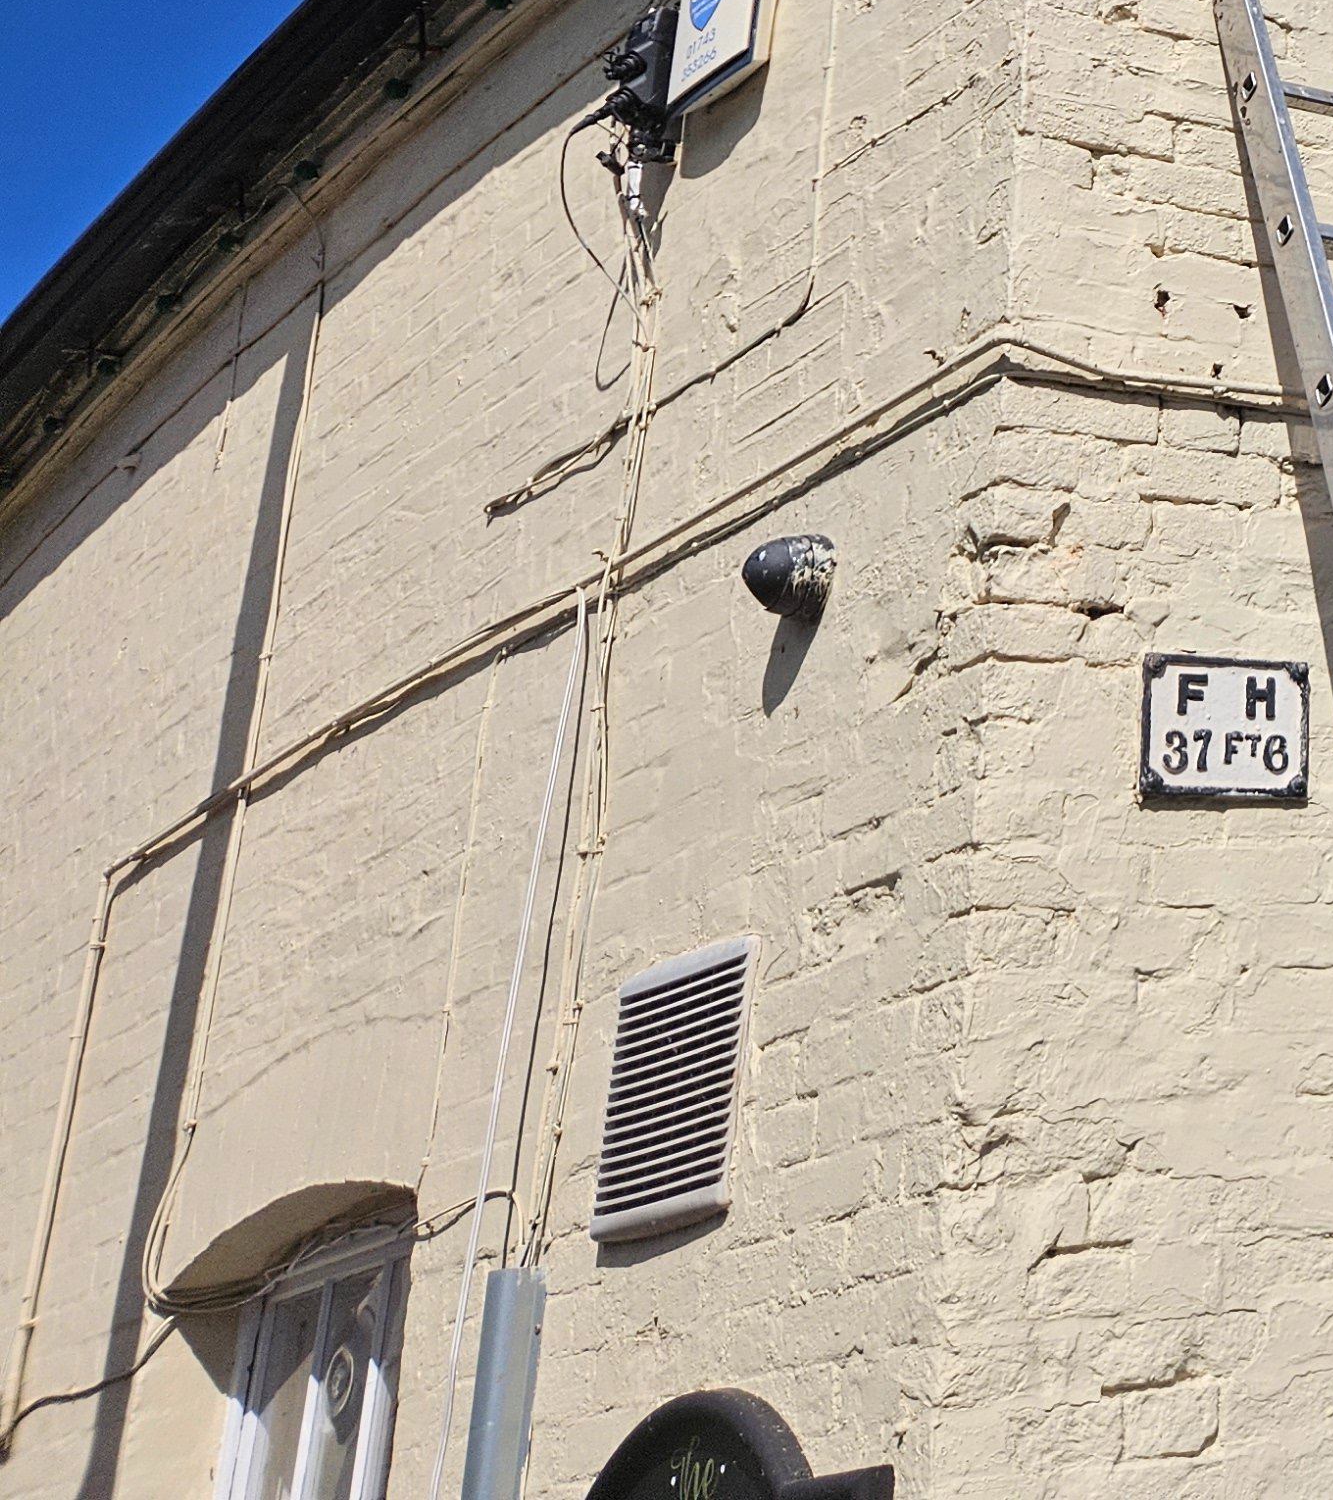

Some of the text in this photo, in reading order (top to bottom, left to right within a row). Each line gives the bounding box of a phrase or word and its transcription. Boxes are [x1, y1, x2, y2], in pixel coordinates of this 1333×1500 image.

[686, 28, 716, 59] 01743
[1177, 673, 1276, 720] F H
